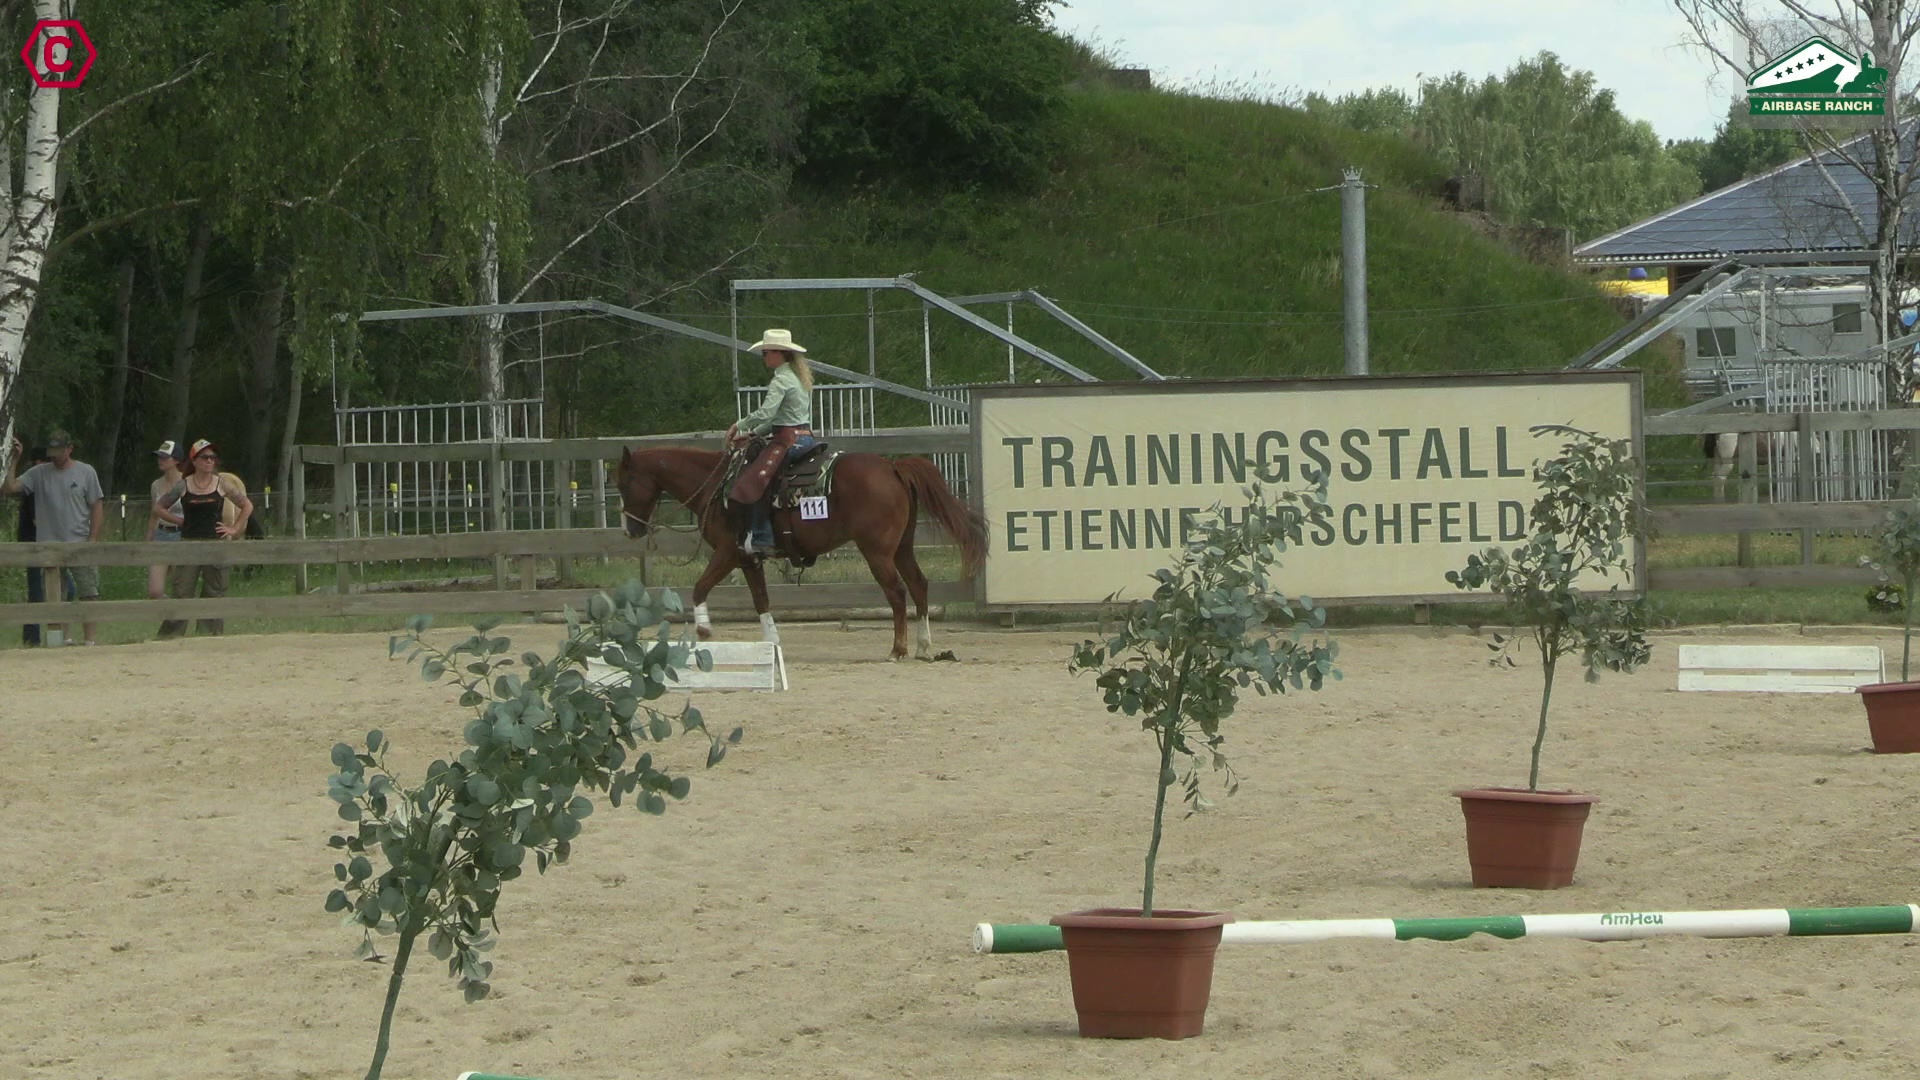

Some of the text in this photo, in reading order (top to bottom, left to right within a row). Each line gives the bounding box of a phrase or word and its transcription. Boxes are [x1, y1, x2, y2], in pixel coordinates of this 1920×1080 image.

[1002, 426, 1525, 488] TRAININGSSTALL
[803, 501, 824, 515] 111
[1006, 507, 1201, 551] ETIENNE
